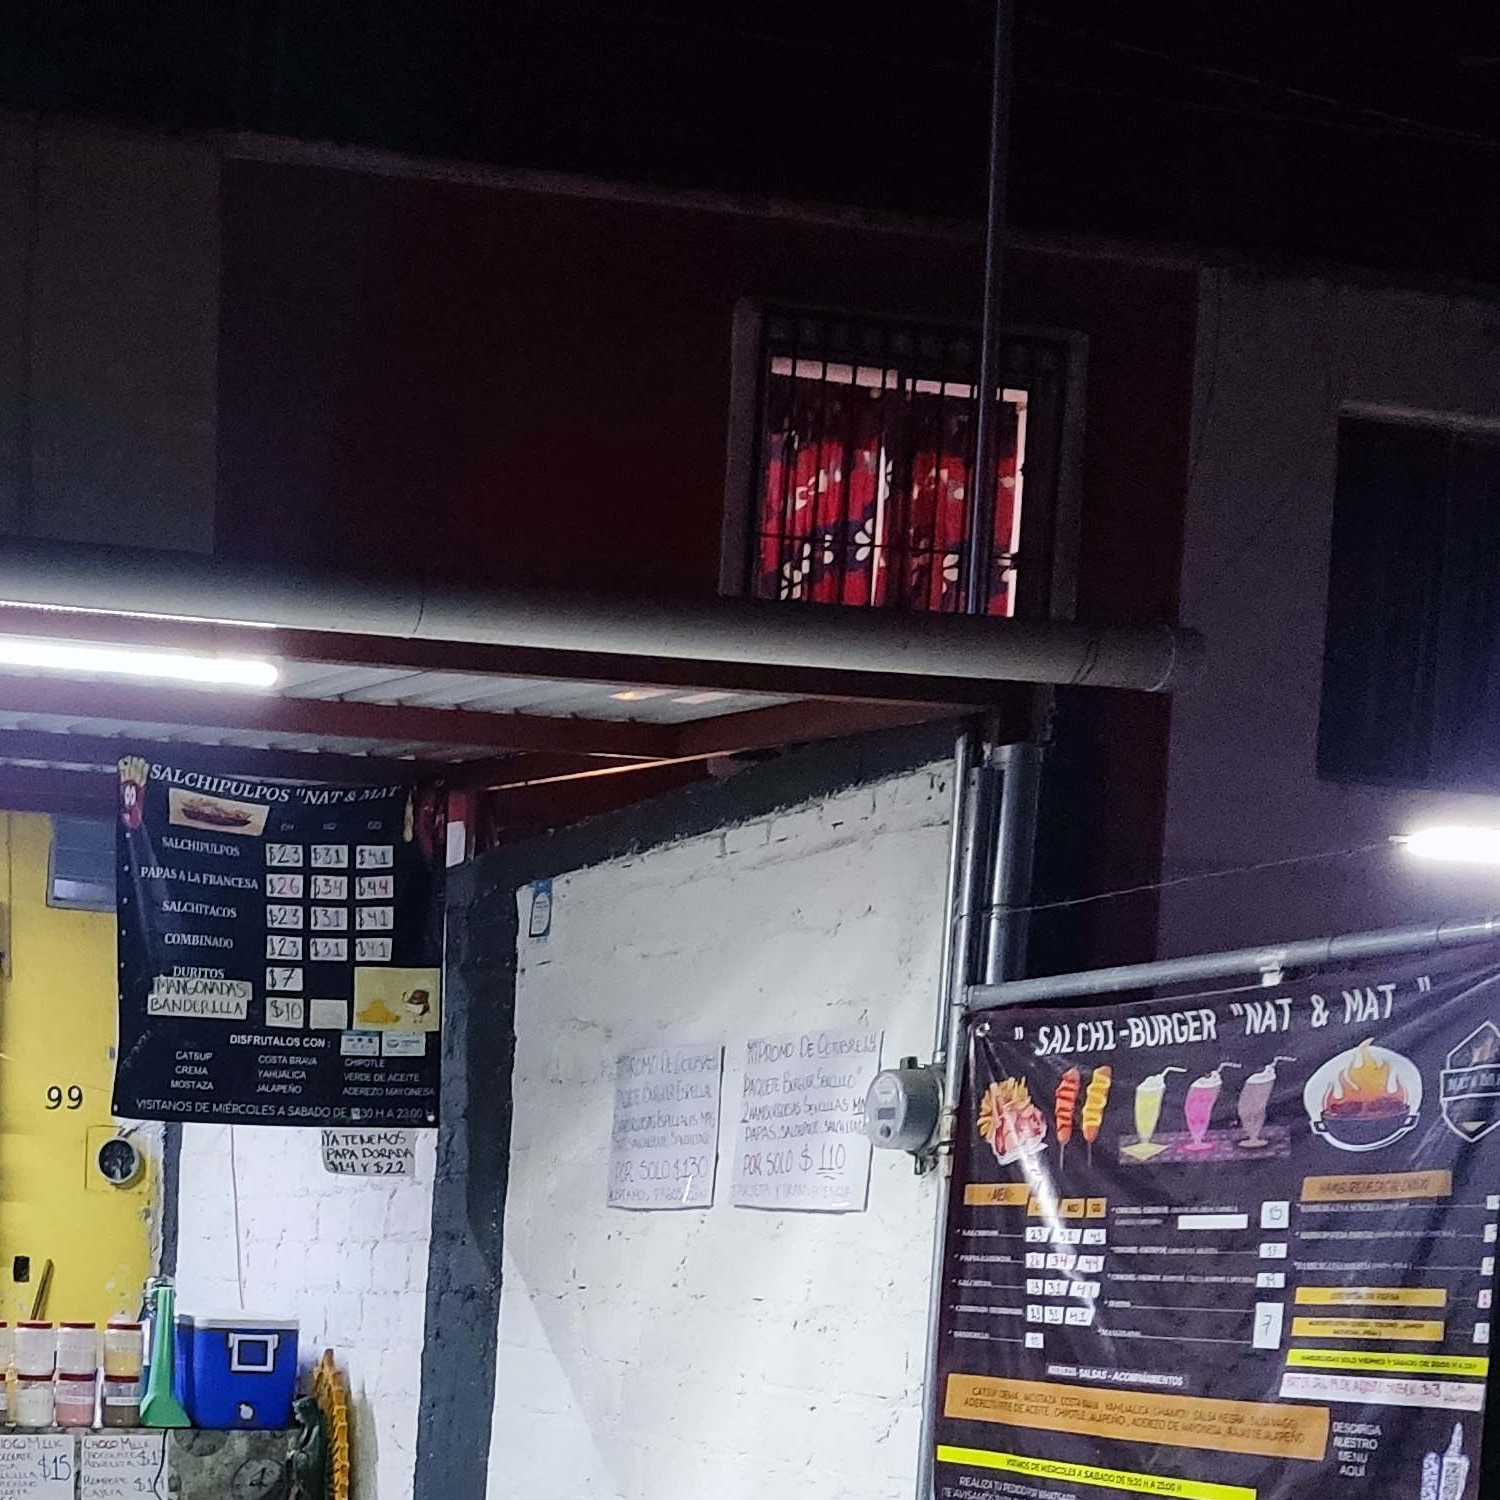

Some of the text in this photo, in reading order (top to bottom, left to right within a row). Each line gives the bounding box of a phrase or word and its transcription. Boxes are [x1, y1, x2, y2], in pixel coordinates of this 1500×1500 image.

[150, 764, 291, 802] SALCHIPULPOS
[343, 790, 357, 802] &
[161, 836, 241, 858] SALCHIPULPOS
[141, 866, 177, 880] PAPAS
[178, 869, 186, 881] A
[187, 870, 201, 883] LA
[202, 873, 259, 890] FRANCESA
[162, 901, 238, 919] SALCHITACOS
[164, 932, 234, 949] COMBINADO
[173, 965, 225, 980] DURITOS
[1034, 1008, 1218, 1057] SALCHI-BURGER
[1310, 994, 1329, 1028] &
[229, 1034, 301, 1047] DISFRUTALOS
[302, 1037, 326, 1048] CON
[175, 1051, 213, 1061] CATSUP
[258, 1055, 288, 1064] COSTA
[175, 1065, 209, 1076] CREMA
[170, 1079, 215, 1090] MOSTAZA
[45, 1085, 83, 1110] 99
[136, 1099, 192, 1112] VISITANOS
[194, 1102, 211, 1112] DE
[212, 1099, 276, 1116] MIÉRCOLES
[277, 1105, 286, 1116] A
[287, 1105, 331, 1118] SABADO
[333, 1107, 347, 1117] DE
[386, 1108, 395, 1118] A
[341, 1130, 407, 1146] TENEMOS
[326, 1147, 414, 1160] PAPA DORADA
[360, 1162, 370, 1173] Y
[37, 1453, 72, 1482] $15
